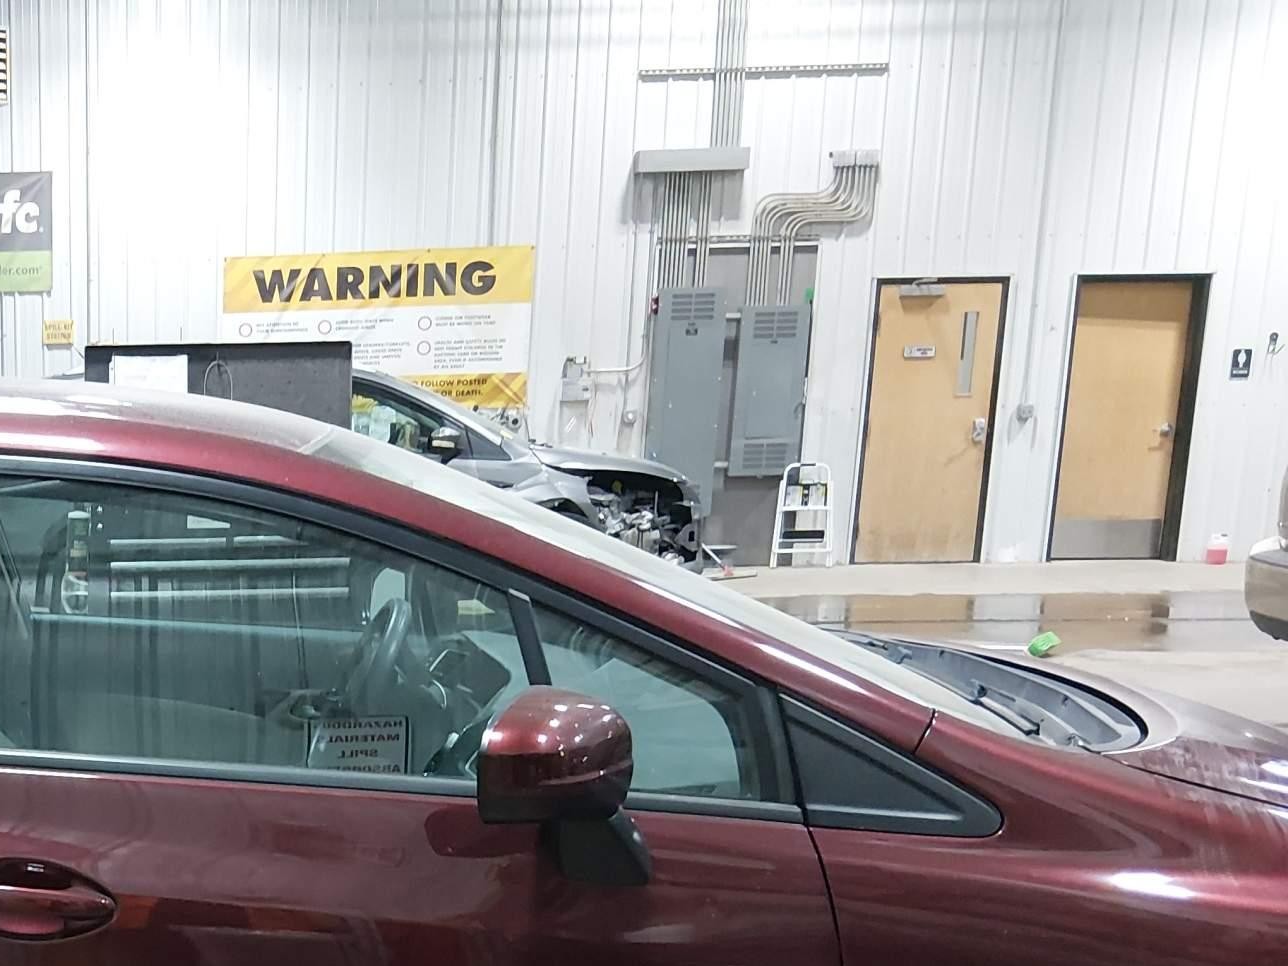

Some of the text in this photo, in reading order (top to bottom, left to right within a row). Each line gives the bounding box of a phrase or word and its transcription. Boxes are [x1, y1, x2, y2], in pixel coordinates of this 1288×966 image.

[253, 260, 496, 304] WARNING
[420, 379, 455, 388] FOLLOW
[456, 377, 488, 387] POSTED
[440, 389, 453, 398] OR
